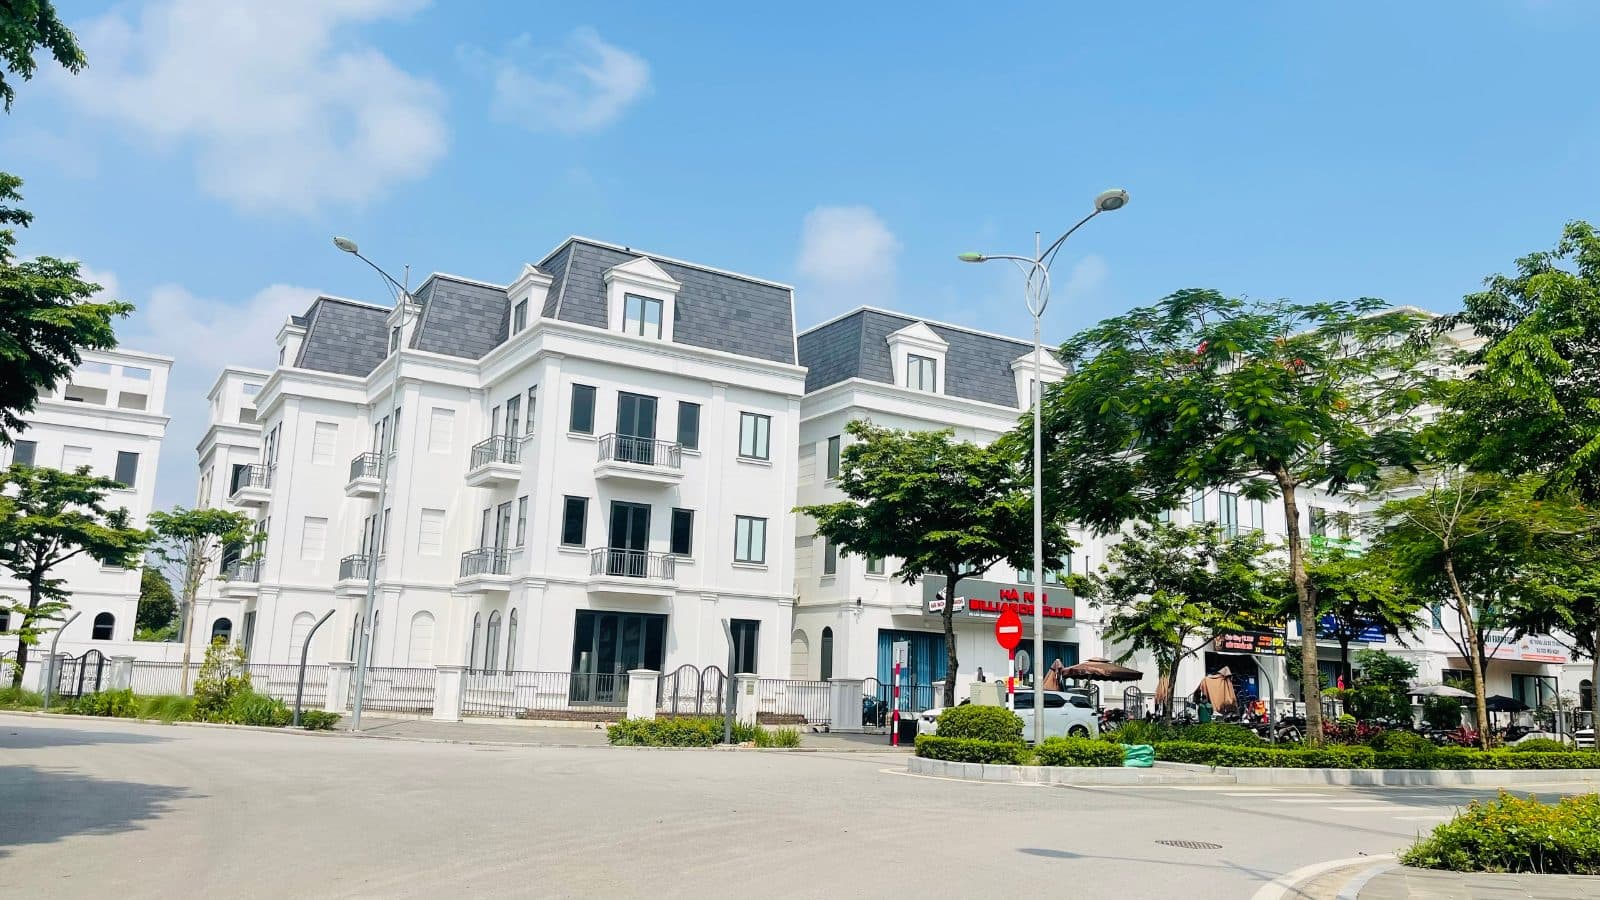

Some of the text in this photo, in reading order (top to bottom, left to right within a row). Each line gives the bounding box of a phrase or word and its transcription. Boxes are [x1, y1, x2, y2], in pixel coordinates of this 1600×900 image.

[1000, 588, 1048, 604] HÀ NI
[1042, 605, 1073, 619] CLUB
